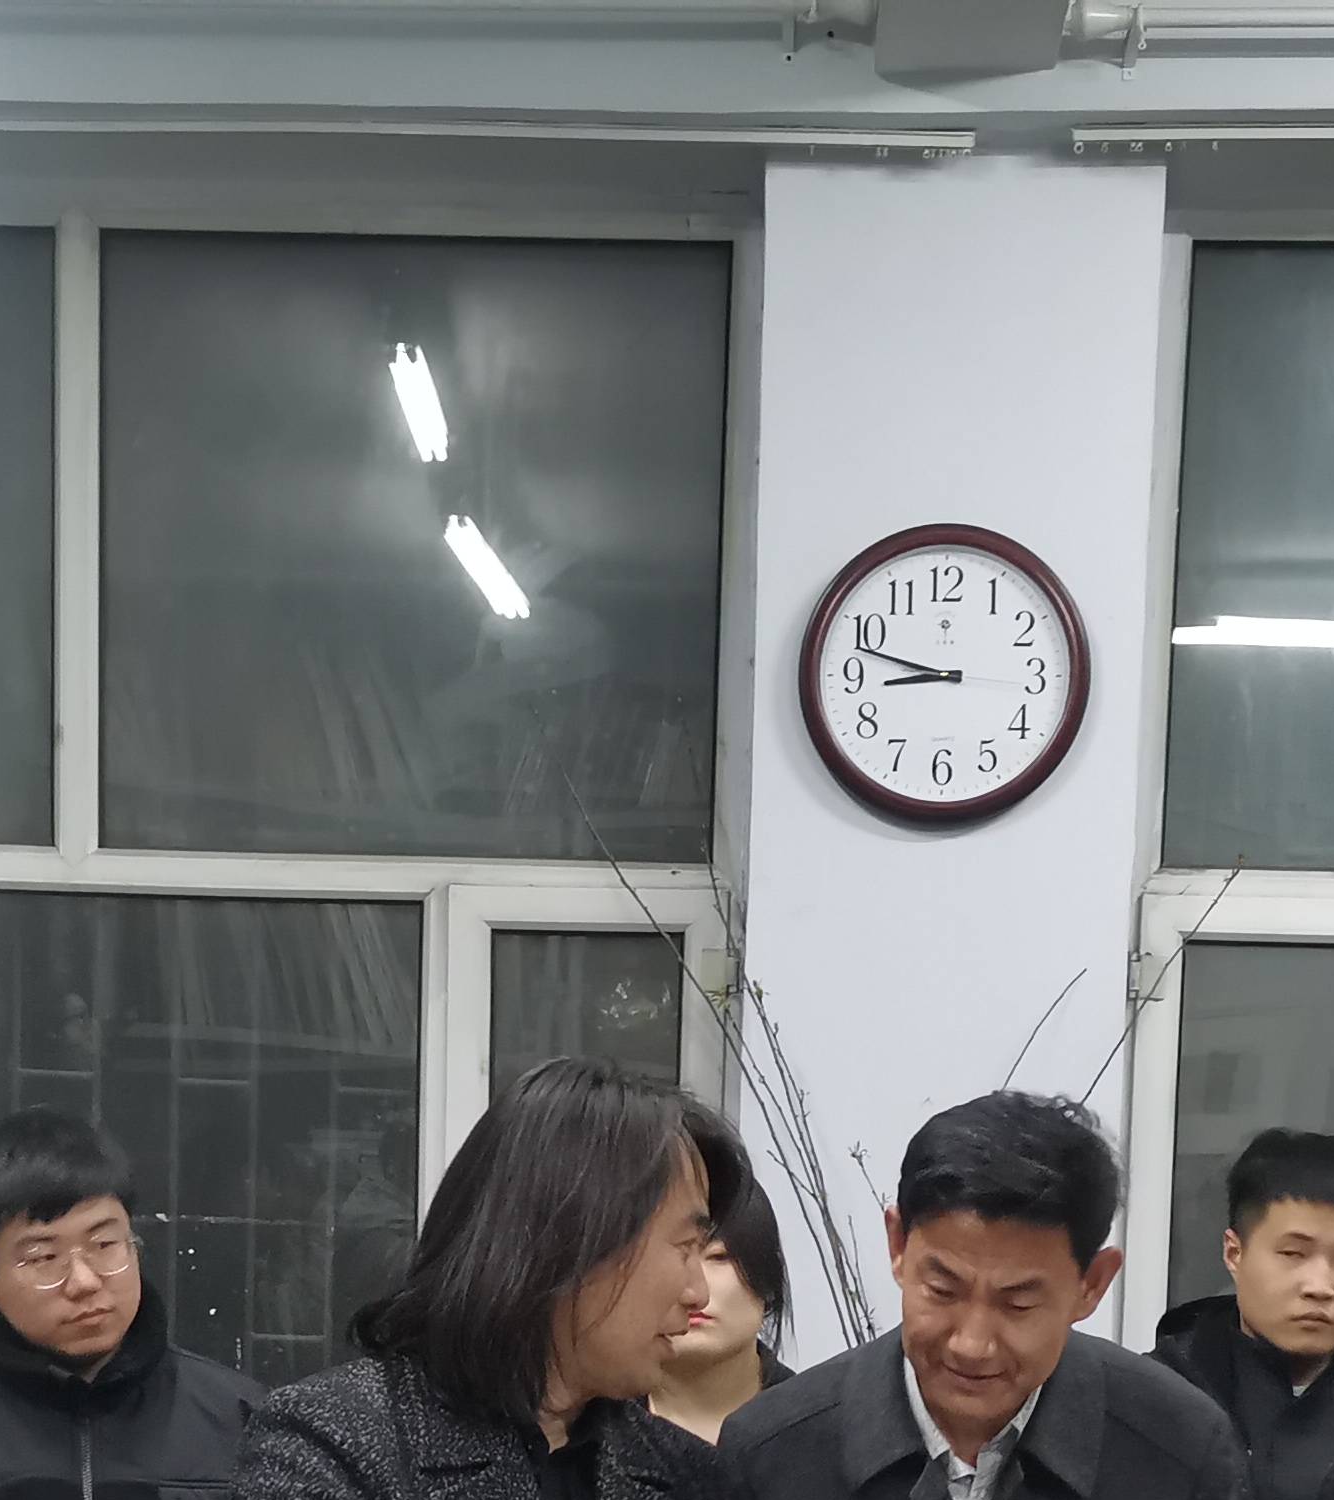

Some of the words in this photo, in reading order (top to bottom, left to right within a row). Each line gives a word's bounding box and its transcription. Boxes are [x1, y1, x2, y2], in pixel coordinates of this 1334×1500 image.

[888, 578, 914, 616] 11
[929, 565, 964, 603] 12
[987, 577, 998, 616] 1
[852, 612, 887, 651] 10
[1012, 610, 1036, 648] 2
[842, 656, 865, 695] 9
[1024, 657, 1047, 695] 3
[855, 701, 879, 740] 8
[1007, 703, 1031, 740] 4
[887, 738, 908, 773] 7
[931, 748, 953, 786] 6
[977, 738, 998, 773] 5
